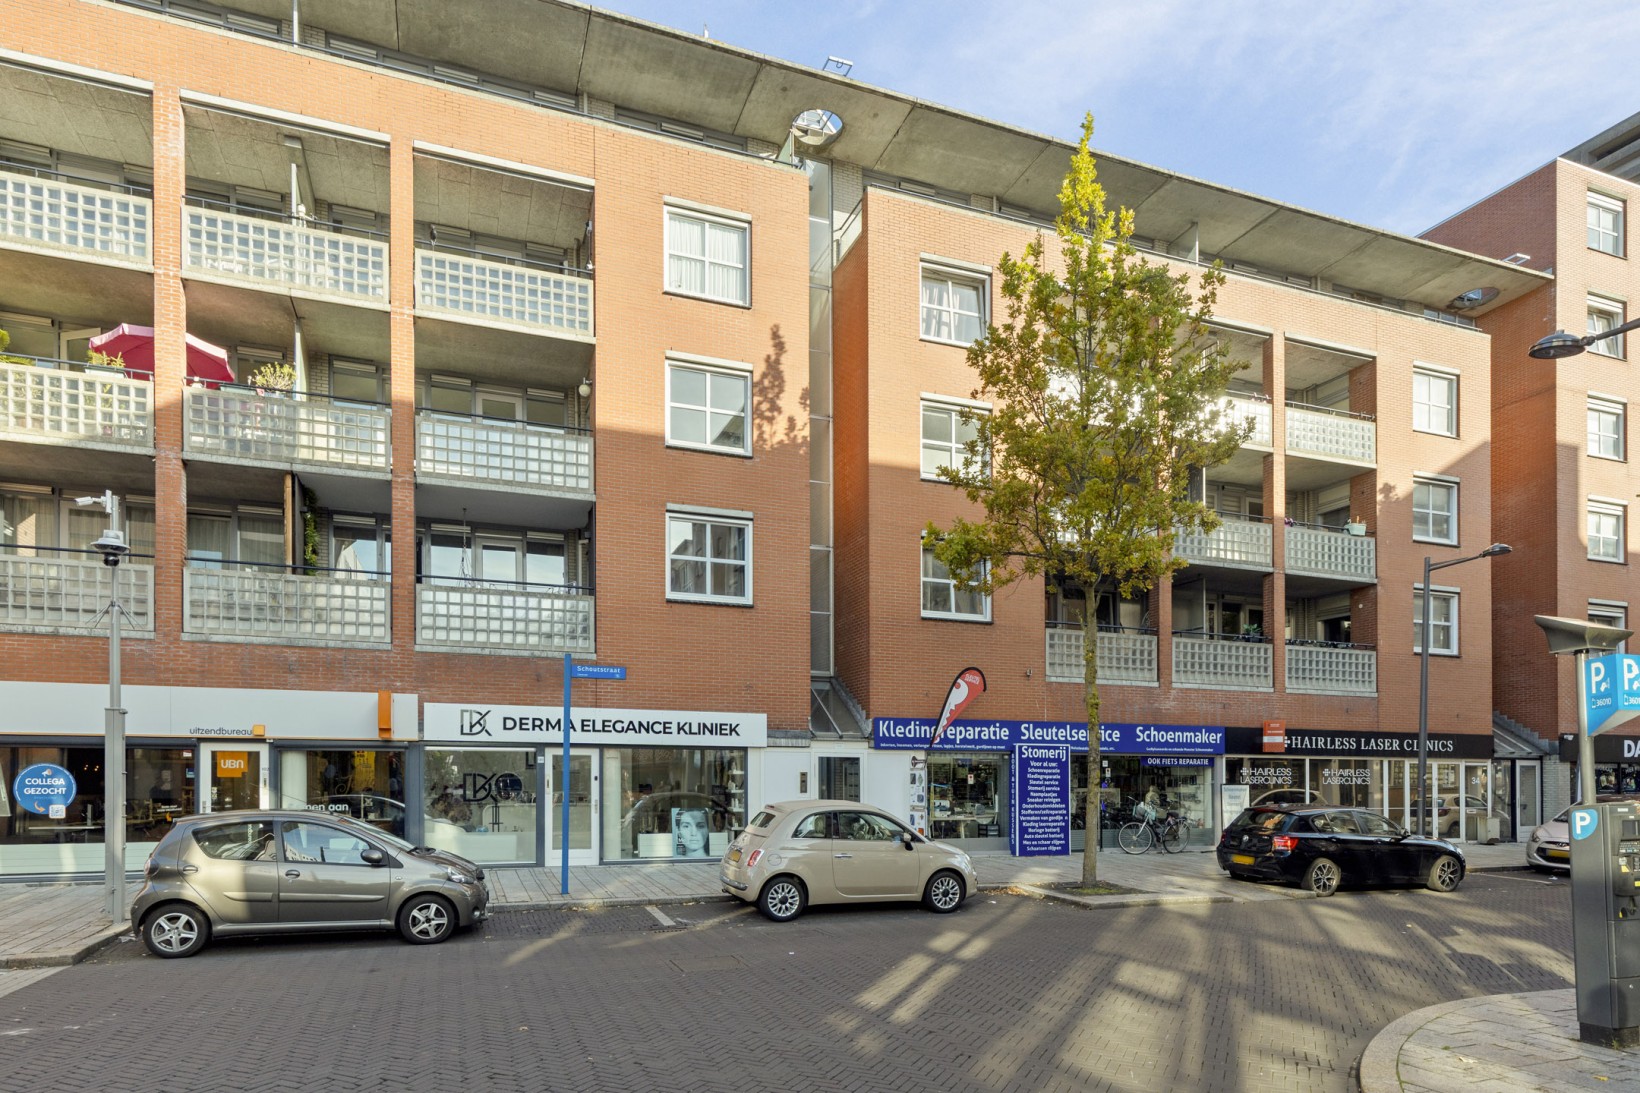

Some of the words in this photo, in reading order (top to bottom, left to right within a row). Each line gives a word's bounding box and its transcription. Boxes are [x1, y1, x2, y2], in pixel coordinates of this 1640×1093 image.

[1590, 662, 1605, 694] P
[1595, 698, 1612, 706] 36010
[1628, 697, 1640, 705] 3601
[189, 727, 253, 736] uitzendbureau
[580, 719, 673, 735] ELEGANCE
[677, 722, 741, 737] KLINIEK
[1020, 723, 1120, 742] Sleutelserice
[1136, 726, 1222, 744] Schoenmaker
[1291, 736, 1356, 750] HAIRLESS
[1360, 738, 1401, 751] LASER
[1403, 739, 1454, 752] CLNICS
[1021, 745, 1067, 762] Stomerij
[1147, 757, 1161, 765] OOK
[1250, 767, 1292, 776] HAIRLESS
[1331, 768, 1371, 777] HAIRLESS
[1240, 775, 1292, 785] LASERCLINICS
[1322, 776, 1371, 785] LASERCLINICS
[1471, 776, 1480, 785] 34
[23, 787, 67, 795] GEZOCHT
[328, 803, 349, 811] aan
[1575, 811, 1591, 834] P
